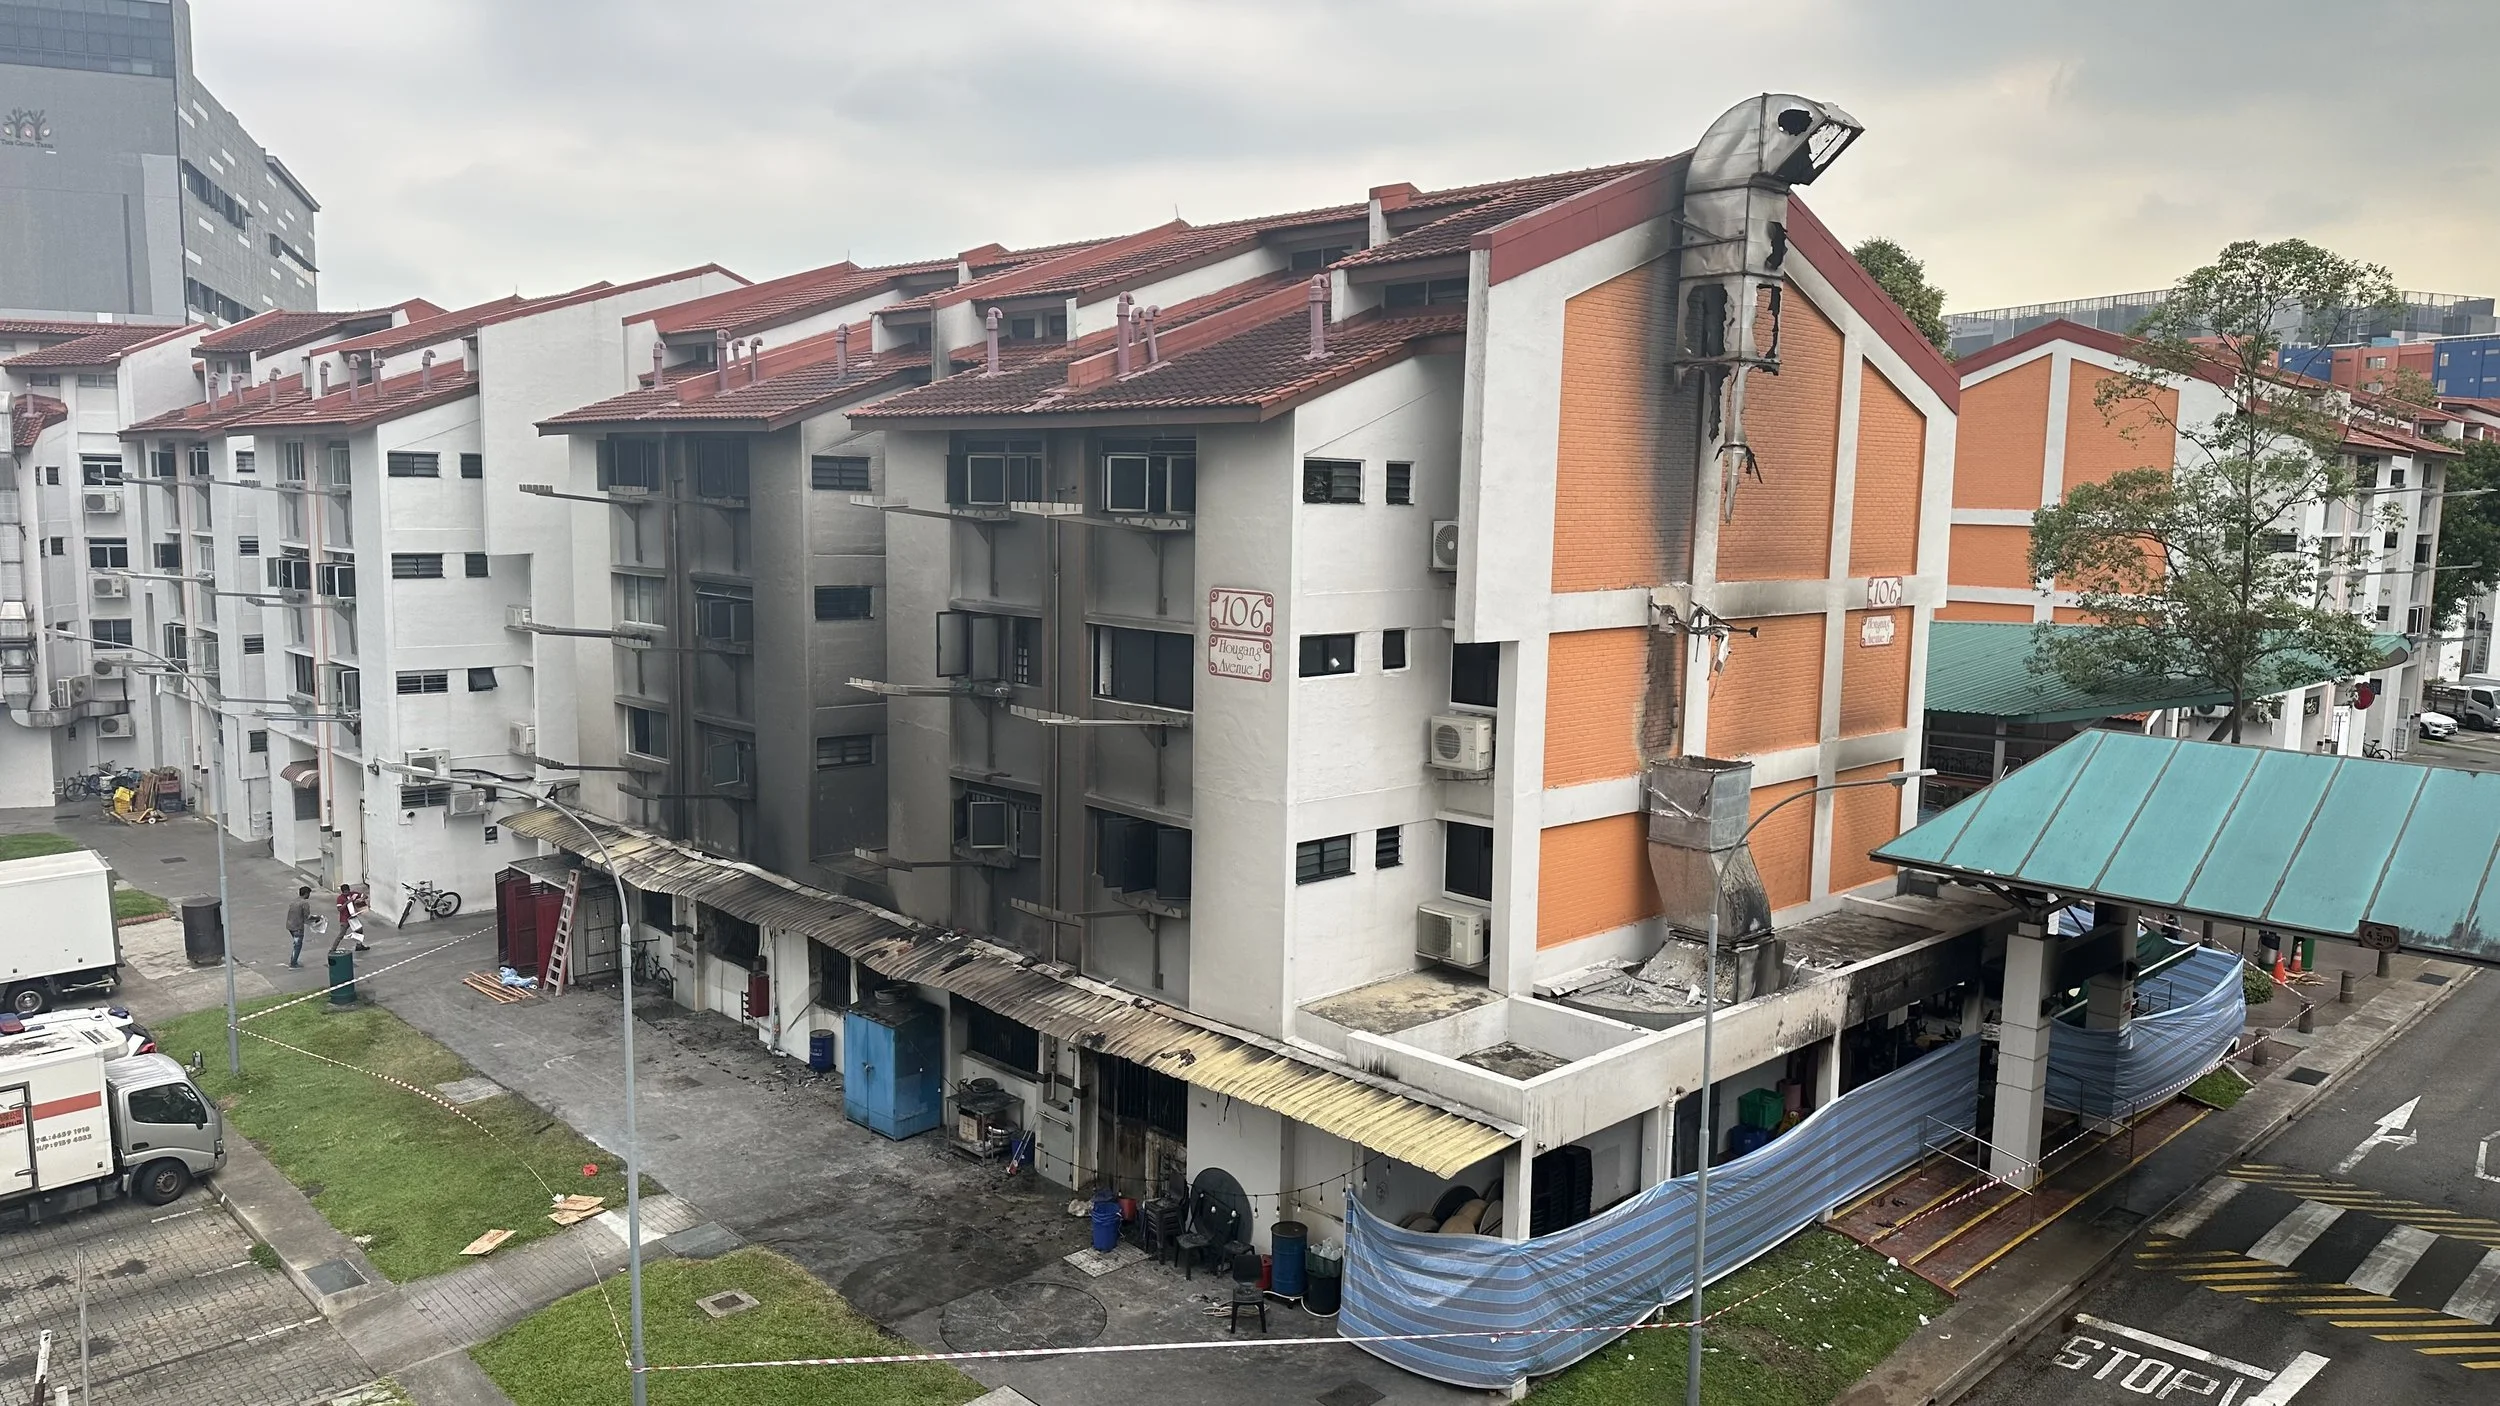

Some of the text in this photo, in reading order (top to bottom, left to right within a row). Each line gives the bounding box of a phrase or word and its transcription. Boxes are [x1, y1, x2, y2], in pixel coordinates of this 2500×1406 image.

[1874, 580, 1897, 604] 106
[1220, 595, 1264, 629] 106
[1218, 640, 1263, 662] Hougang
[1218, 659, 1262, 677] Avenue 1
[2366, 931, 2393, 943] 4.5m
[2051, 1335, 2221, 1400] STOP
